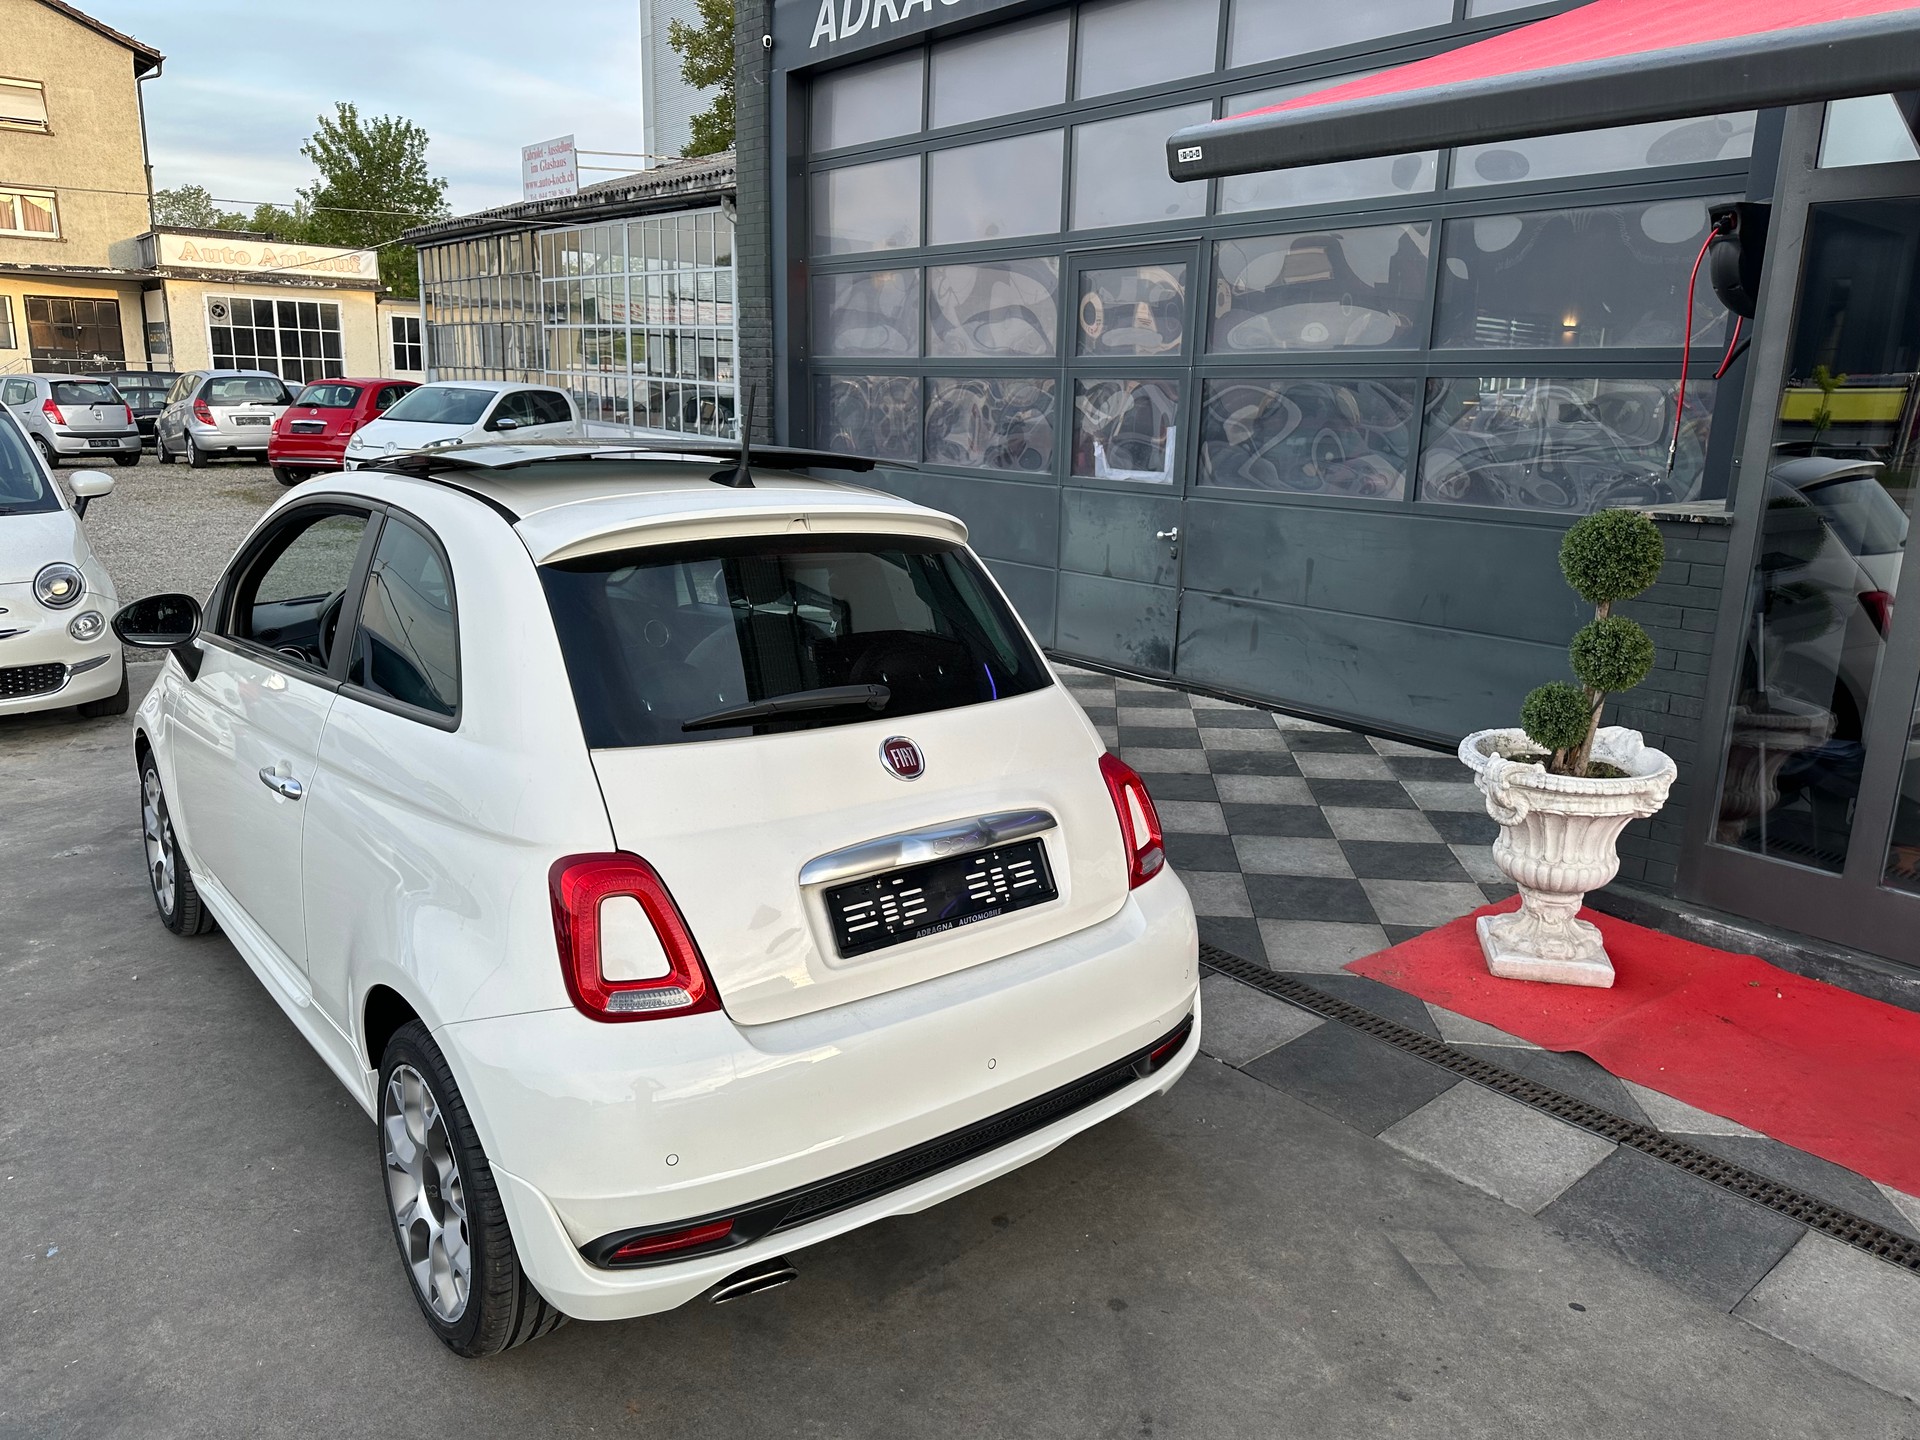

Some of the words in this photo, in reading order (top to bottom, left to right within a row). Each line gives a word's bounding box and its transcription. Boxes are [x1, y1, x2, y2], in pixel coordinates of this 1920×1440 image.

[530, 162, 539, 174] im
[540, 158, 567, 172] Glashaus
[179, 241, 251, 266] Auto
[258, 247, 361, 273] Ankauf
[890, 747, 917, 769] FIAT
[916, 921, 953, 938] ADRAGNA
[959, 908, 1002, 926] AUTOMOBILE
